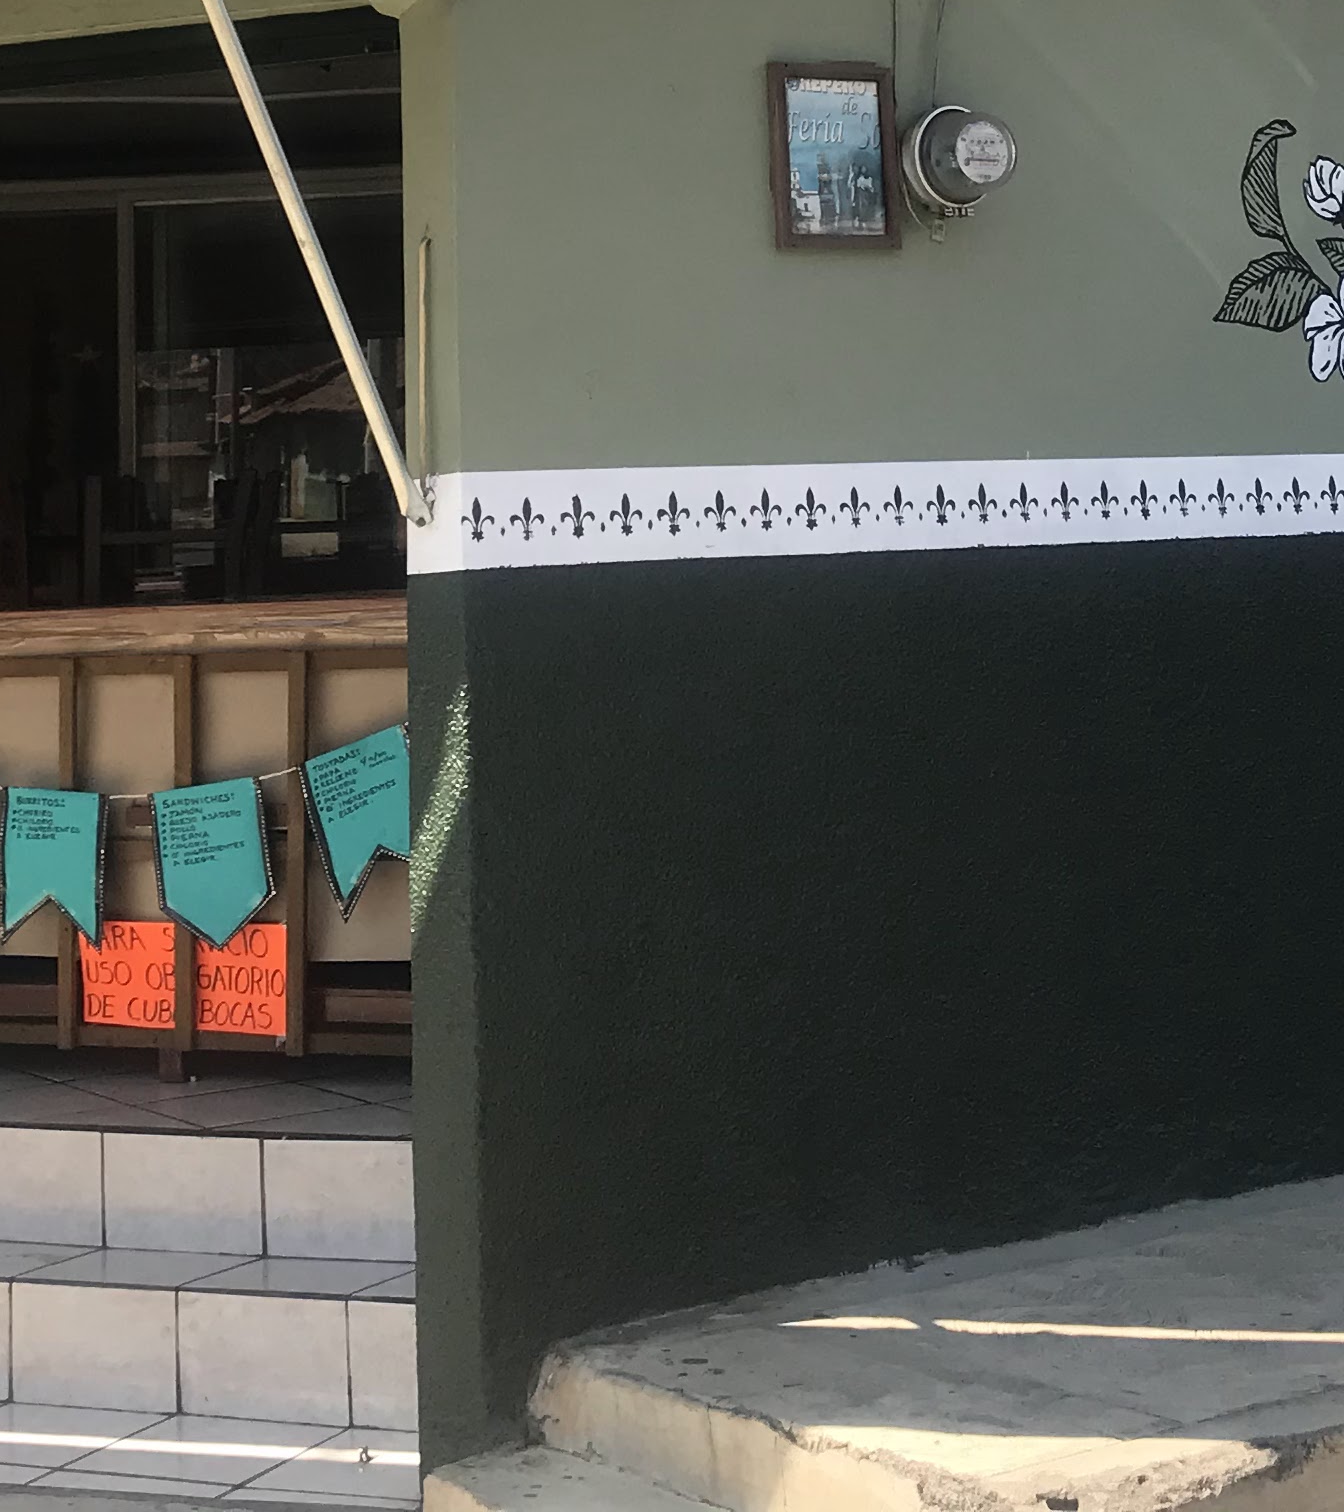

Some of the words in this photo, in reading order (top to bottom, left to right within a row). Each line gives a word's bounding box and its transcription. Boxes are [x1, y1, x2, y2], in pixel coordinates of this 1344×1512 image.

[85, 924, 148, 952] ARA
[85, 960, 133, 986] USO
[144, 962, 285, 998] OBGATORIO
[87, 992, 116, 1019] DE
[126, 996, 273, 1030] CUBBOCAS
